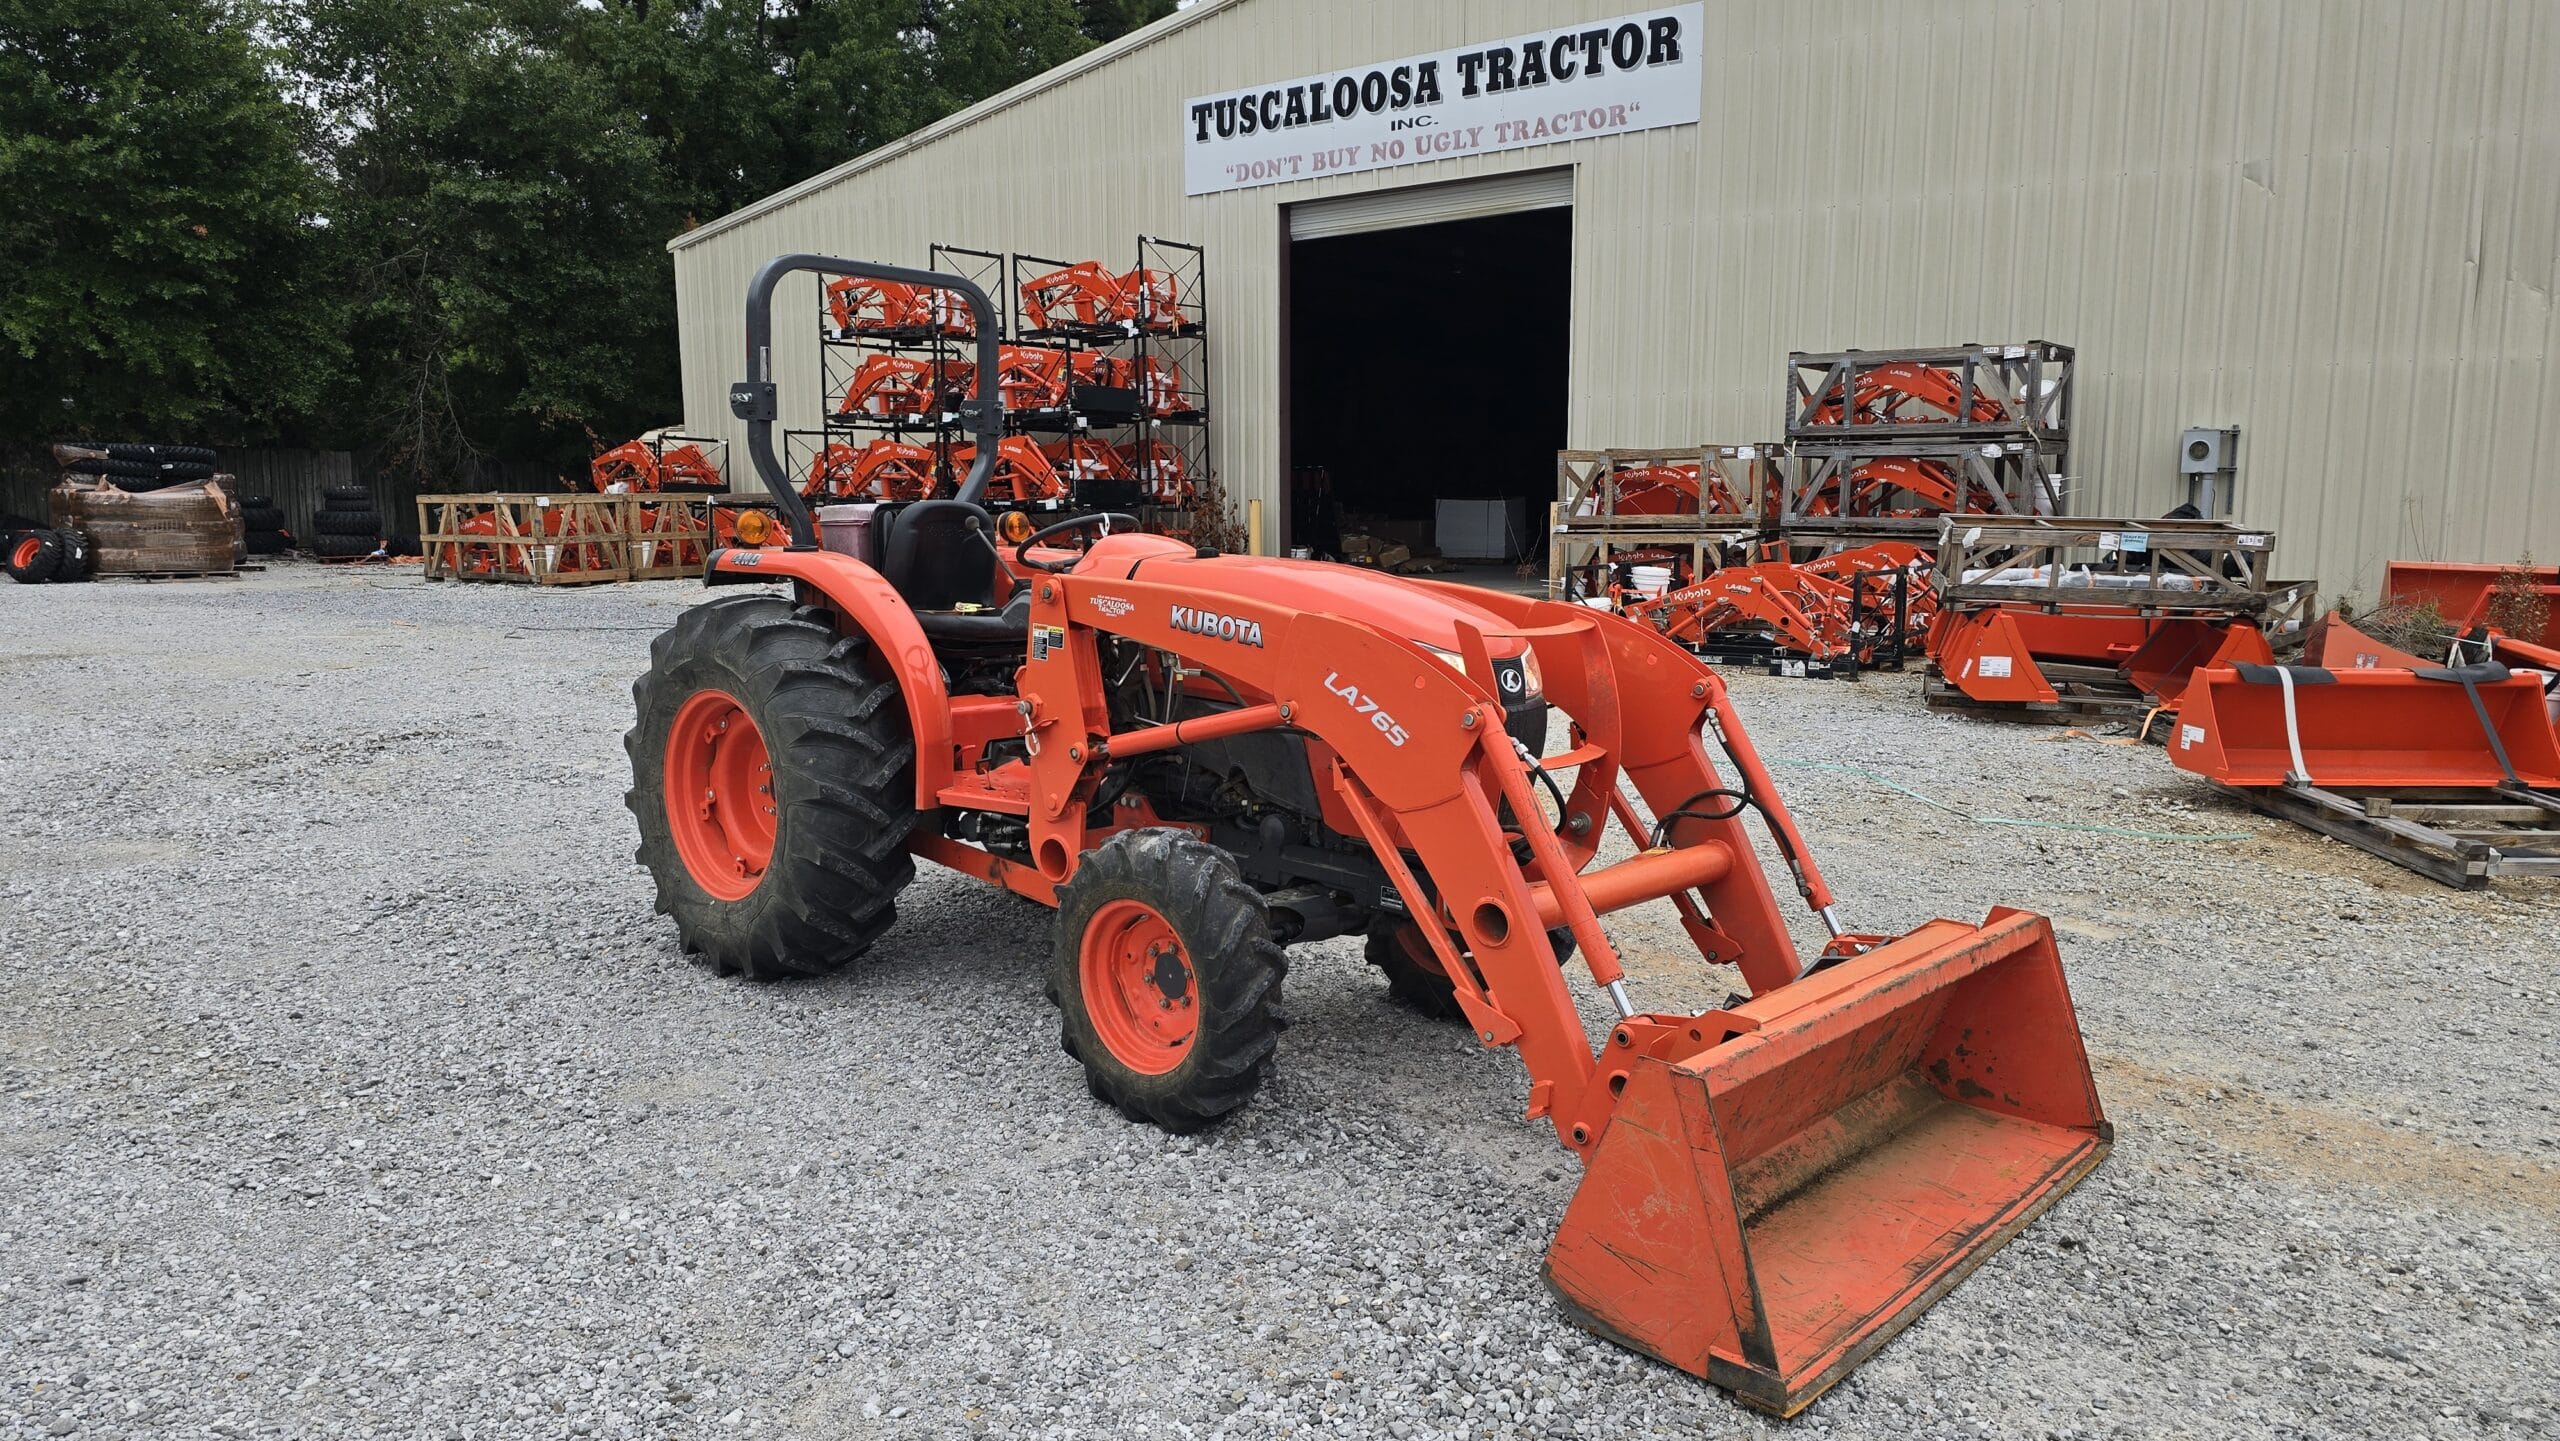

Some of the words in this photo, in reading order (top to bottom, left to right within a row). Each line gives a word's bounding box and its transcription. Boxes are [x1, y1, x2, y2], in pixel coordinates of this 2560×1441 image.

[1192, 60, 1442, 142] TUSCALOOSA
[1457, 16, 1682, 98] TRACTOR
[1391, 115, 1439, 131] INC.
[1312, 145, 1361, 172] BUY
[1371, 139, 1406, 163] NO
[1415, 126, 1484, 156] UGLY
[1624, 470, 1650, 479] Kubota
[1618, 552, 1644, 561] Kubota
[1803, 560, 1836, 573] Kubota
[1674, 588, 1711, 602] Kubota
[1090, 597, 1135, 611] TUSCALOOSA
[1170, 604, 1264, 648] KUBOTA
[1324, 671, 1410, 747] LA765
